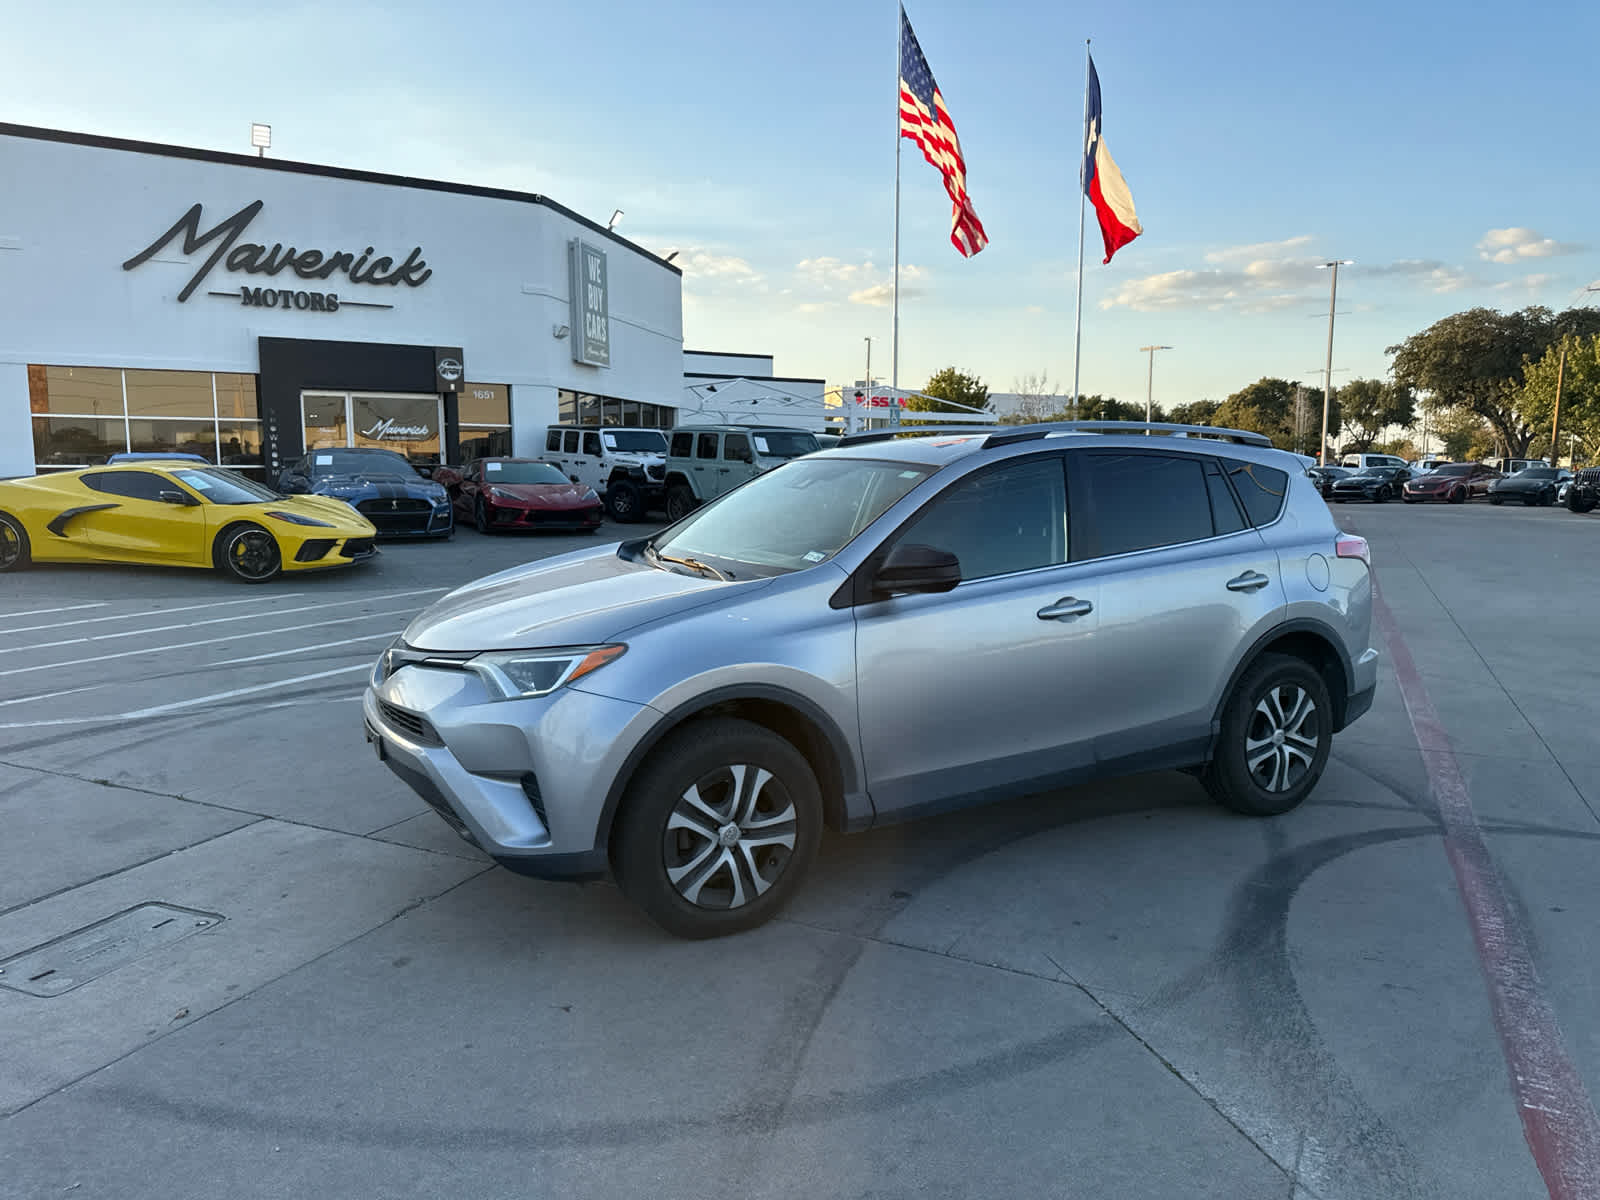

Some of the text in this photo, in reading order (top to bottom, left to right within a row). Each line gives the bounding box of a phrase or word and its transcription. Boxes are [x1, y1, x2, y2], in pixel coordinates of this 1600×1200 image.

[122, 199, 433, 302] Maverick
[587, 254, 601, 283] WE
[240, 286, 340, 312] MOTORS
[588, 283, 603, 312] BUY
[586, 311, 607, 342] CARS
[473, 390, 494, 400] 1651
[855, 395, 908, 408] NSSN
[361, 417, 430, 440] Maverick
